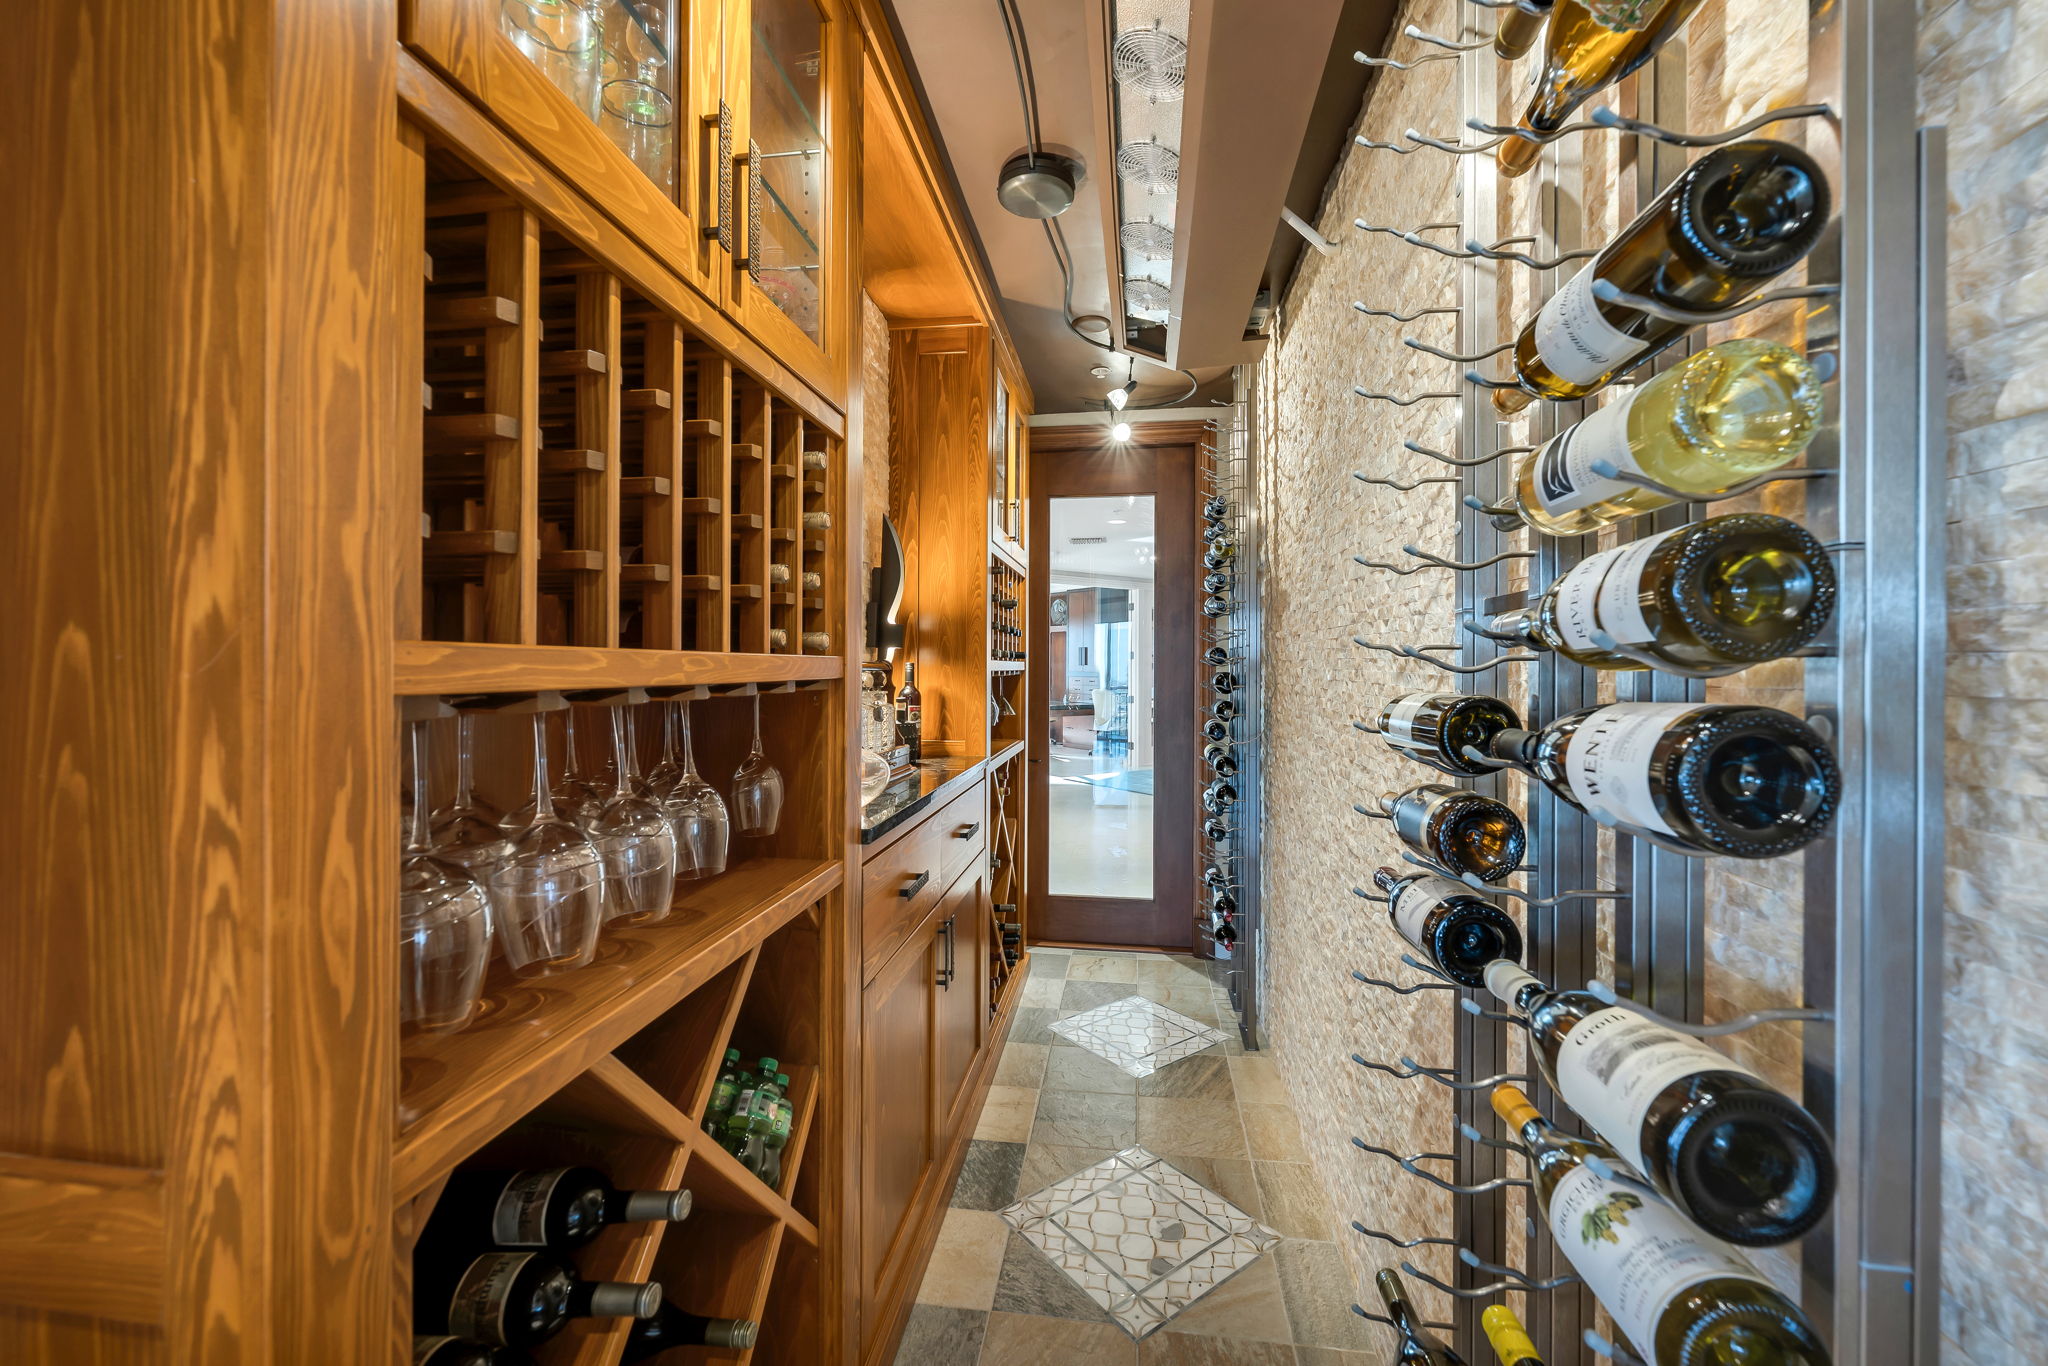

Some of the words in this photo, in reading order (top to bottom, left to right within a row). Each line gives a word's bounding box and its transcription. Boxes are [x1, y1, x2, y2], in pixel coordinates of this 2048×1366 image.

[1570, 582, 1587, 639] RIVER
[1583, 713, 1624, 796] WENTE
[1575, 1014, 1626, 1046] Groth
